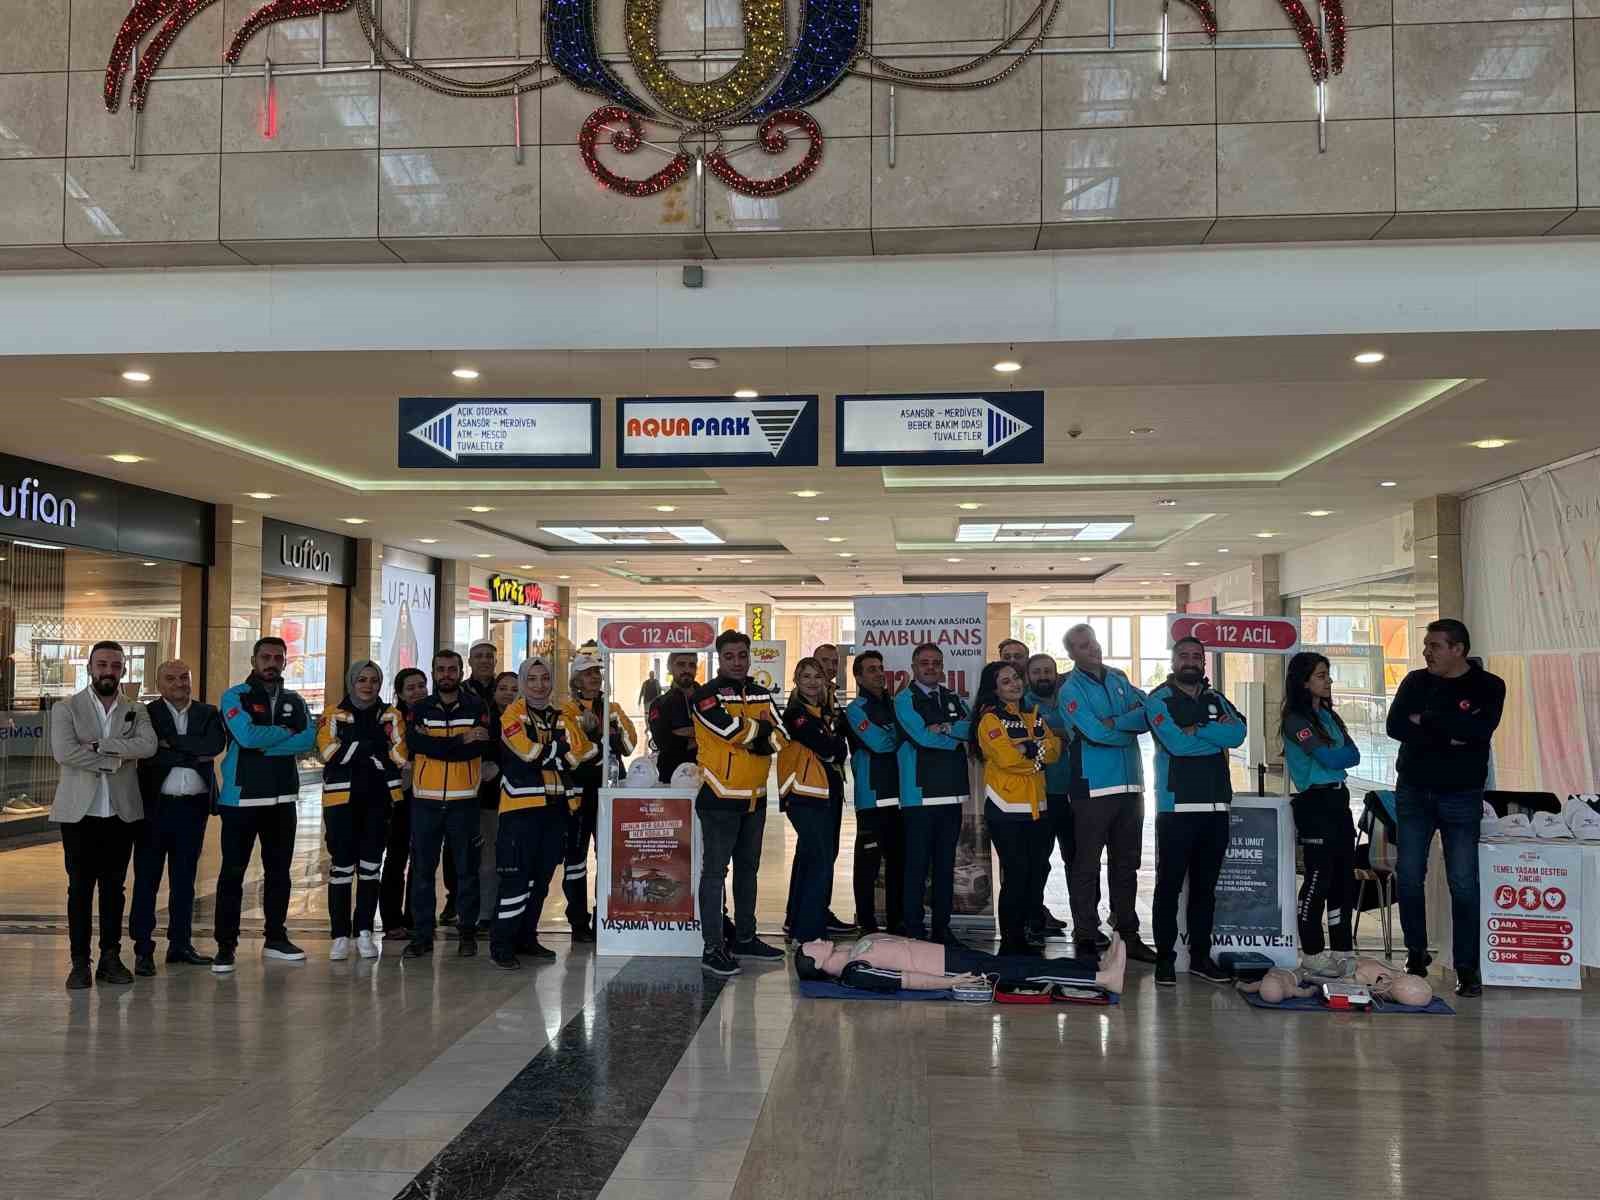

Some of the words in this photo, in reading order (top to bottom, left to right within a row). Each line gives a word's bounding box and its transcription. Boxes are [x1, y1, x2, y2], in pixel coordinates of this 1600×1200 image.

[475, 407, 508, 416] OTOPARK
[900, 408, 935, 418] ASANSÖR
[944, 406, 983, 418] MERDİVEN
[457, 417, 490, 427] ASANSÖR
[500, 416, 537, 428] MERDİVEN
[627, 417, 750, 438] AQUAPARK
[907, 420, 933, 430] BEBEK
[935, 420, 959, 430] BAKIM
[961, 420, 983, 429] ODASI
[457, 430, 472, 439] ATM
[933, 431, 982, 441] TUVALETLER
[457, 441, 504, 450] TUVALETLER
[281, 533, 331, 572] Lufian
[861, 618, 889, 628] YAŞAM
[891, 617, 903, 626] İLE
[938, 617, 981, 625] ARASINDA
[641, 627, 661, 643] 112
[665, 625, 696, 643] ACİL
[863, 628, 982, 646] AMBULANS
[1216, 625, 1238, 642] 112
[1242, 624, 1276, 643] ACİL
[950, 648, 982, 657] VARDIR
[1225, 848, 1263, 859] UMKE
[1493, 865, 1514, 874] TEMEL
[601, 918, 649, 933] YAŞAMA
[651, 919, 675, 931] YOL
[676, 920, 701, 931] VER
[1500, 920, 1518, 929] ARA
[1236, 934, 1262, 947] YOL
[1500, 936, 1518, 944] BAS
